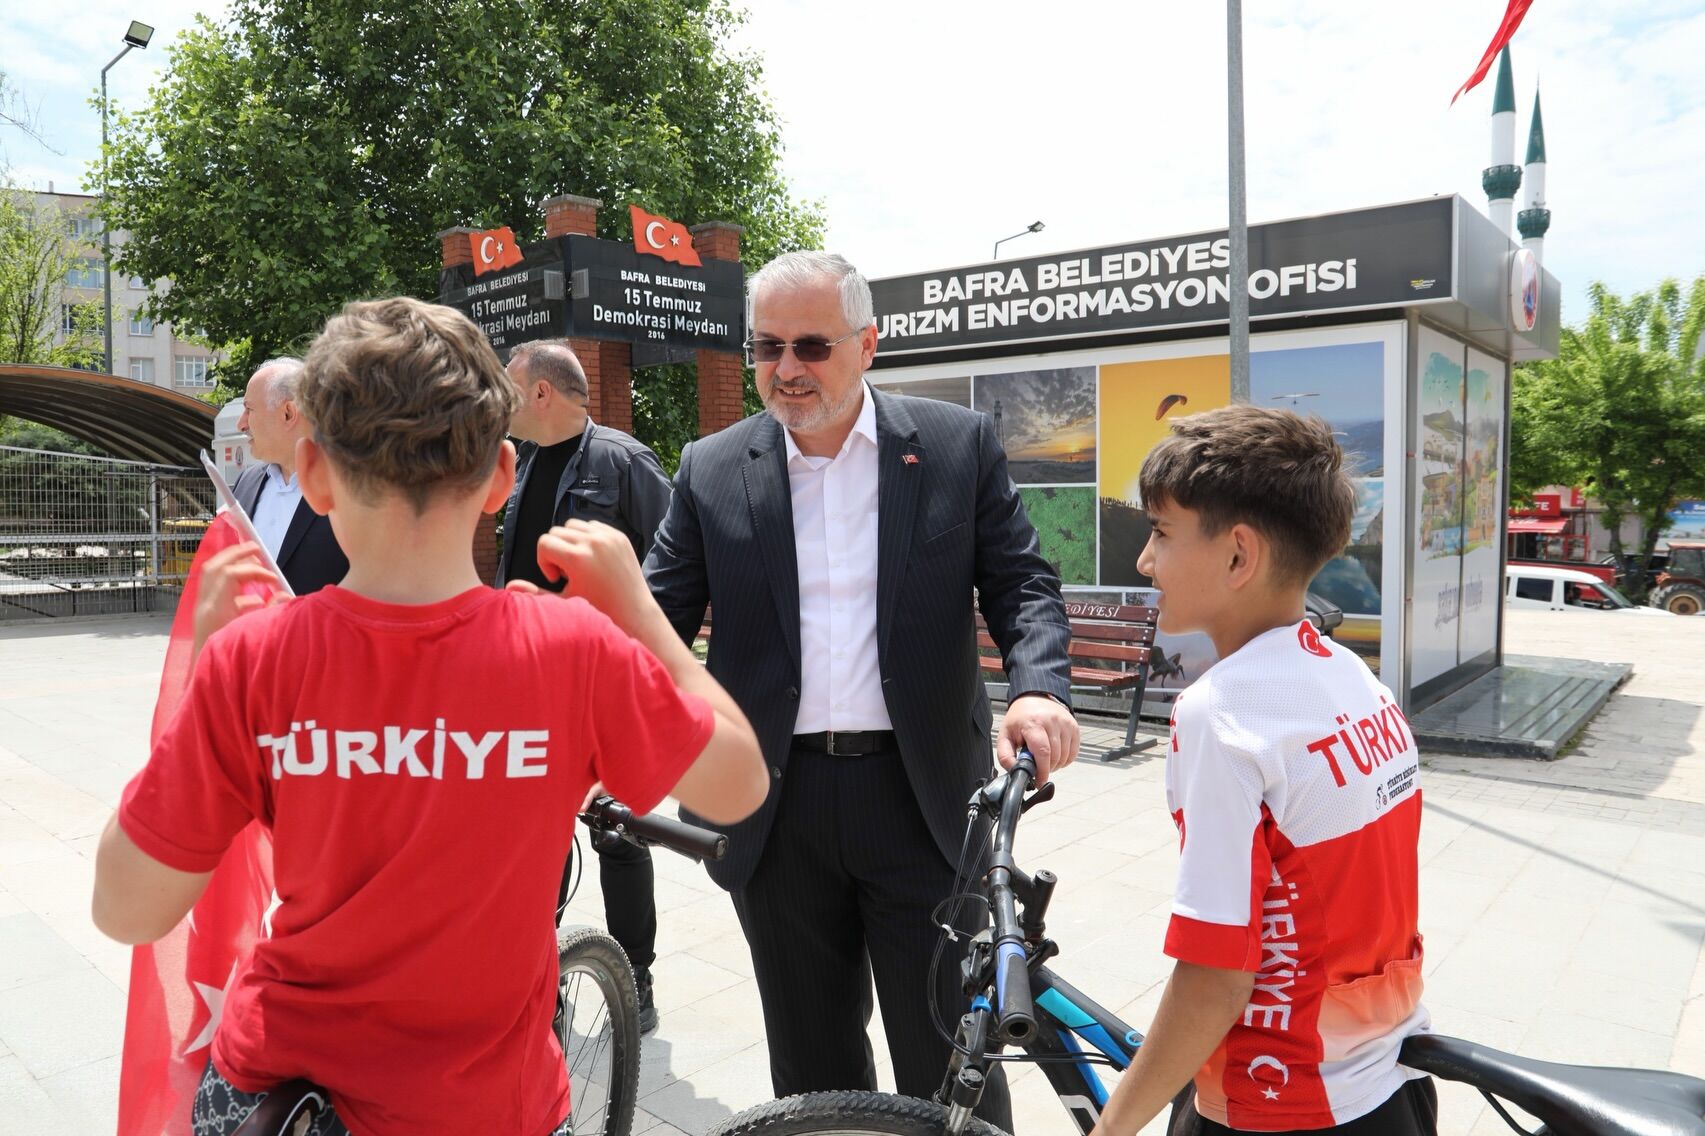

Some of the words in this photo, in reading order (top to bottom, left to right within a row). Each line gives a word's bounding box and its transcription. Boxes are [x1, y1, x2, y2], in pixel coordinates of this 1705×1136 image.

[620, 270, 651, 284] BAFRA
[923, 267, 1030, 305] BAFRA
[1037, 238, 1230, 291] BELEDİYES
[467, 282, 488, 297] BAFRA
[624, 287, 641, 306] 15
[643, 290, 702, 313] Temmuz
[872, 306, 960, 340] URİZM
[967, 274, 1230, 330] ENFORMASYON
[1247, 258, 1357, 300] OFİSİ
[471, 301, 483, 318] 15
[484, 294, 528, 316] Temmuz
[479, 315, 504, 335] krasi
[506, 309, 550, 332] Meydanı
[593, 304, 671, 330] Demokrasi
[674, 314, 728, 336] Meydanı
[492, 335, 506, 346] 2016
[647, 330, 666, 340] 2016
[1064, 602, 1121, 618] EDİYESİ
[256, 717, 550, 780] TÜRKİYE
